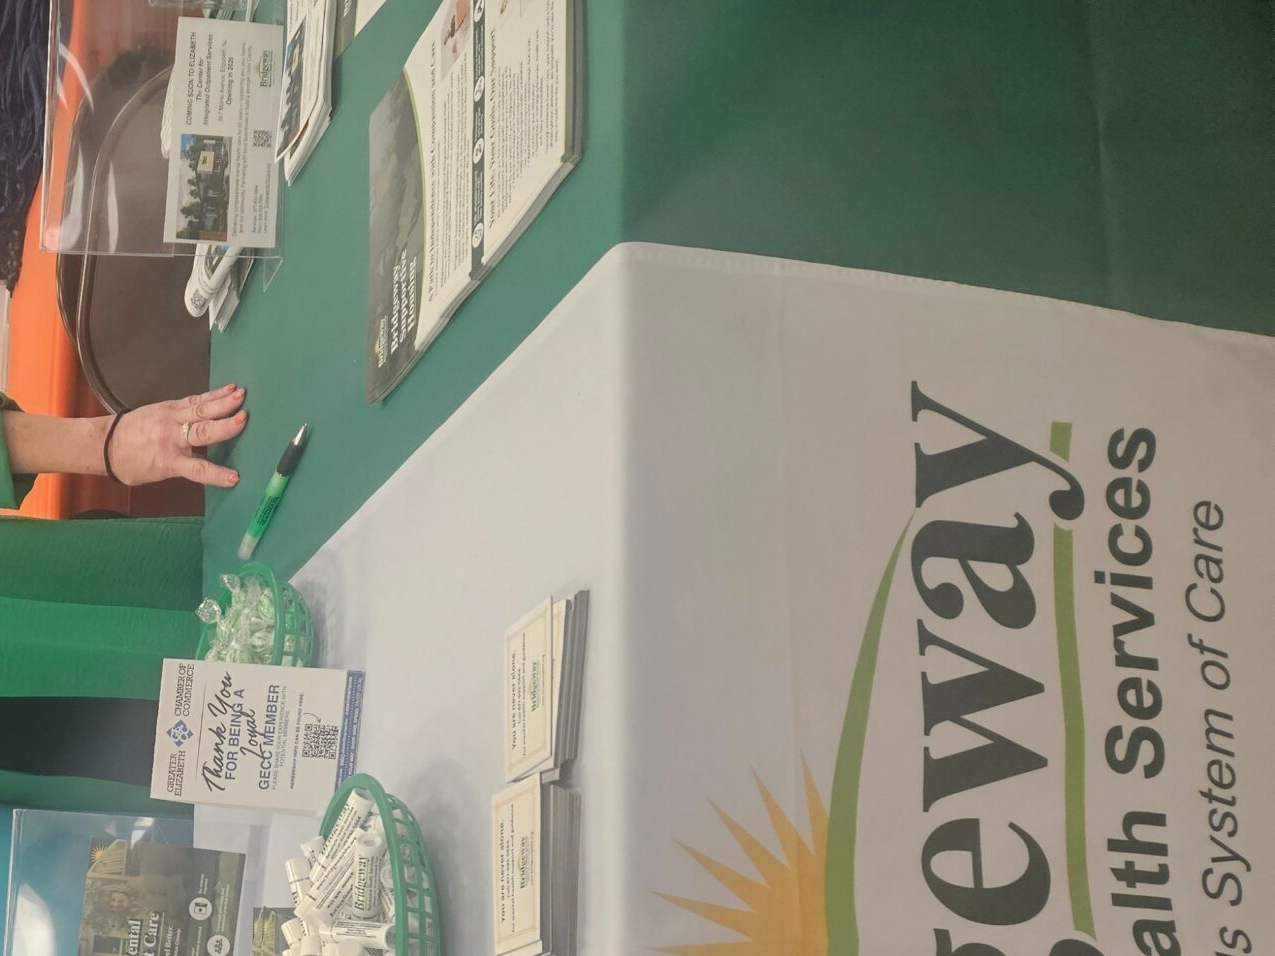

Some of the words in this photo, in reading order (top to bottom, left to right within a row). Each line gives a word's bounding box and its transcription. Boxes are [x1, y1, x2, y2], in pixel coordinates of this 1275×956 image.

[189, 69, 195, 77] TO
[204, 61, 212, 92] Outpatient
[259, 50, 271, 87] Bridgeway
[226, 79, 234, 104] Opening
[390, 263, 400, 354] Bridgeway
[399, 249, 408, 343] Supportive
[407, 256, 417, 332] Housing
[1184, 500, 1226, 623] Care
[1093, 427, 1165, 780] Services
[179, 663, 186, 674] OF
[1187, 633, 1228, 691] of
[175, 675, 185, 717] CHAMBER
[183, 664, 195, 717] COMMERCE
[207, 672, 233, 717] You
[233, 689, 245, 699] A
[229, 703, 243, 746] BEING
[239, 709, 266, 761] Loyal
[263, 684, 280, 746] MEMBER
[167, 753, 177, 793] GREATER
[174, 750, 186, 797] ELIZABETH
[201, 721, 226, 792] Thank
[225, 751, 239, 780] FOR
[258, 750, 273, 790] GECC
[1198, 709, 1251, 908] System
[355, 855, 370, 910] Bridgeway
[143, 912, 160, 947] Care
[165, 926, 173, 948] Better.
